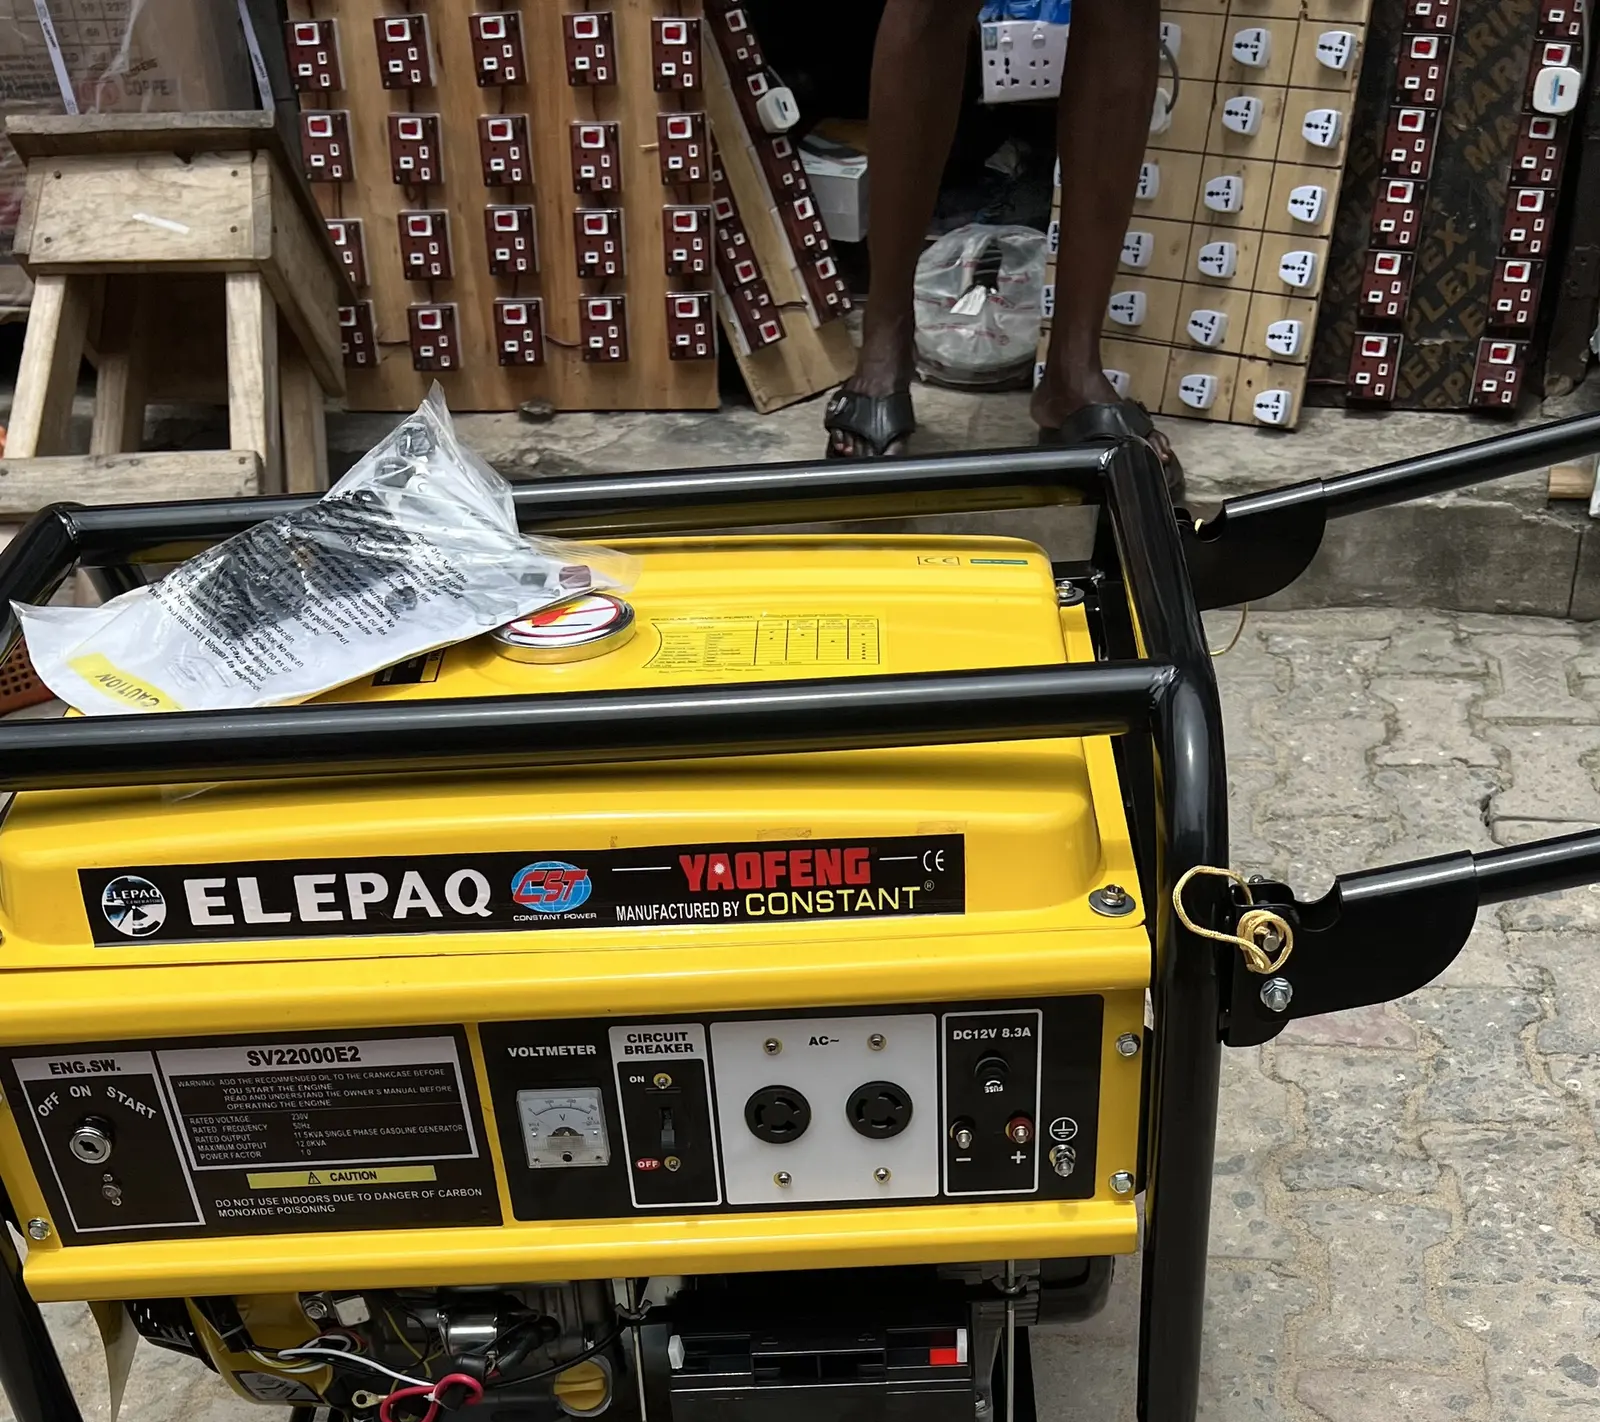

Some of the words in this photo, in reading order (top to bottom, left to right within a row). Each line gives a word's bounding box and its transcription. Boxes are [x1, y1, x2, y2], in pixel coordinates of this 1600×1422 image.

[95, 673, 160, 707] CAUTION
[678, 847, 871, 892] YAOFENG
[513, 869, 588, 904] CST
[183, 868, 493, 926] ELEPAQ
[616, 902, 719, 921] MANUFACTURED
[723, 901, 740, 917] BY
[745, 886, 921, 916] CONSTANT
[564, 912, 597, 920] POWER
[626, 1031, 689, 1043] CIRCUIT
[953, 1028, 997, 1040] DC12V
[1002, 1027, 1031, 1038] 8.3A
[507, 1045, 597, 1058] VOLTMETER
[623, 1043, 694, 1055] BREAKER
[247, 1046, 361, 1067] SV22000E2
[48, 1059, 121, 1075] ENG.SW.
[220, 1078, 236, 1086] ADD
[238, 1077, 253, 1085] THE
[255, 1075, 317, 1085] RECOMMENDED
[318, 1074, 332, 1082] OIL
[333, 1073, 345, 1081] TO
[346, 1072, 361, 1080] THE
[363, 1070, 412, 1079] CRANKCASE
[413, 1068, 445, 1077] BEFORE
[222, 1087, 243, 1095] YOU
[245, 1085, 275, 1094] START
[297, 1083, 332, 1092] ENGINE
[224, 1094, 248, 1102] READ
[249, 1093, 267, 1101] AND
[268, 1091, 324, 1100] UNDERSTAND
[326, 1090, 342, 1098] THE
[383, 1086, 418, 1095] MANUAL
[419, 1085, 452, 1093] BEFORE
[37, 1092, 60, 1117] OFF
[69, 1085, 92, 1098] ON
[106, 1086, 157, 1119] START
[227, 1102, 278, 1111] OPERATING
[279, 1100, 296, 1108] THE
[298, 1099, 332, 1107] ENGINE
[189, 1117, 214, 1125] RATED
[216, 1115, 250, 1124] VOLTAGE
[192, 1126, 217, 1134] RATED
[222, 1124, 268, 1133] FREQUENCY
[194, 1135, 220, 1143] RATED
[221, 1134, 252, 1142] OUTPUT
[325, 1129, 351, 1138] SINGLE
[353, 1128, 379, 1136] PHASE
[380, 1126, 417, 1135] GASOLINE
[419, 1124, 464, 1133] GENERATOR
[197, 1143, 234, 1152] MAXIMUM
[236, 1142, 267, 1150] OUTPUT
[200, 1152, 229, 1160] POWER
[231, 1150, 262, 1159] FACTOR
[637, 1160, 658, 1169] OFF
[329, 1171, 377, 1182] CAUTION
[215, 1199, 231, 1208] DO
[233, 1198, 255, 1207] NOT
[258, 1197, 280, 1206] USE
[282, 1194, 330, 1204] INDOORS
[332, 1193, 355, 1202] DUE
[357, 1192, 372, 1201] TO
[374, 1190, 420, 1200] DANGER
[421, 1190, 436, 1198] OF
[438, 1188, 482, 1198] CARBON
[218, 1207, 274, 1217] MONOXIDE
[276, 1204, 336, 1215] POISONING
